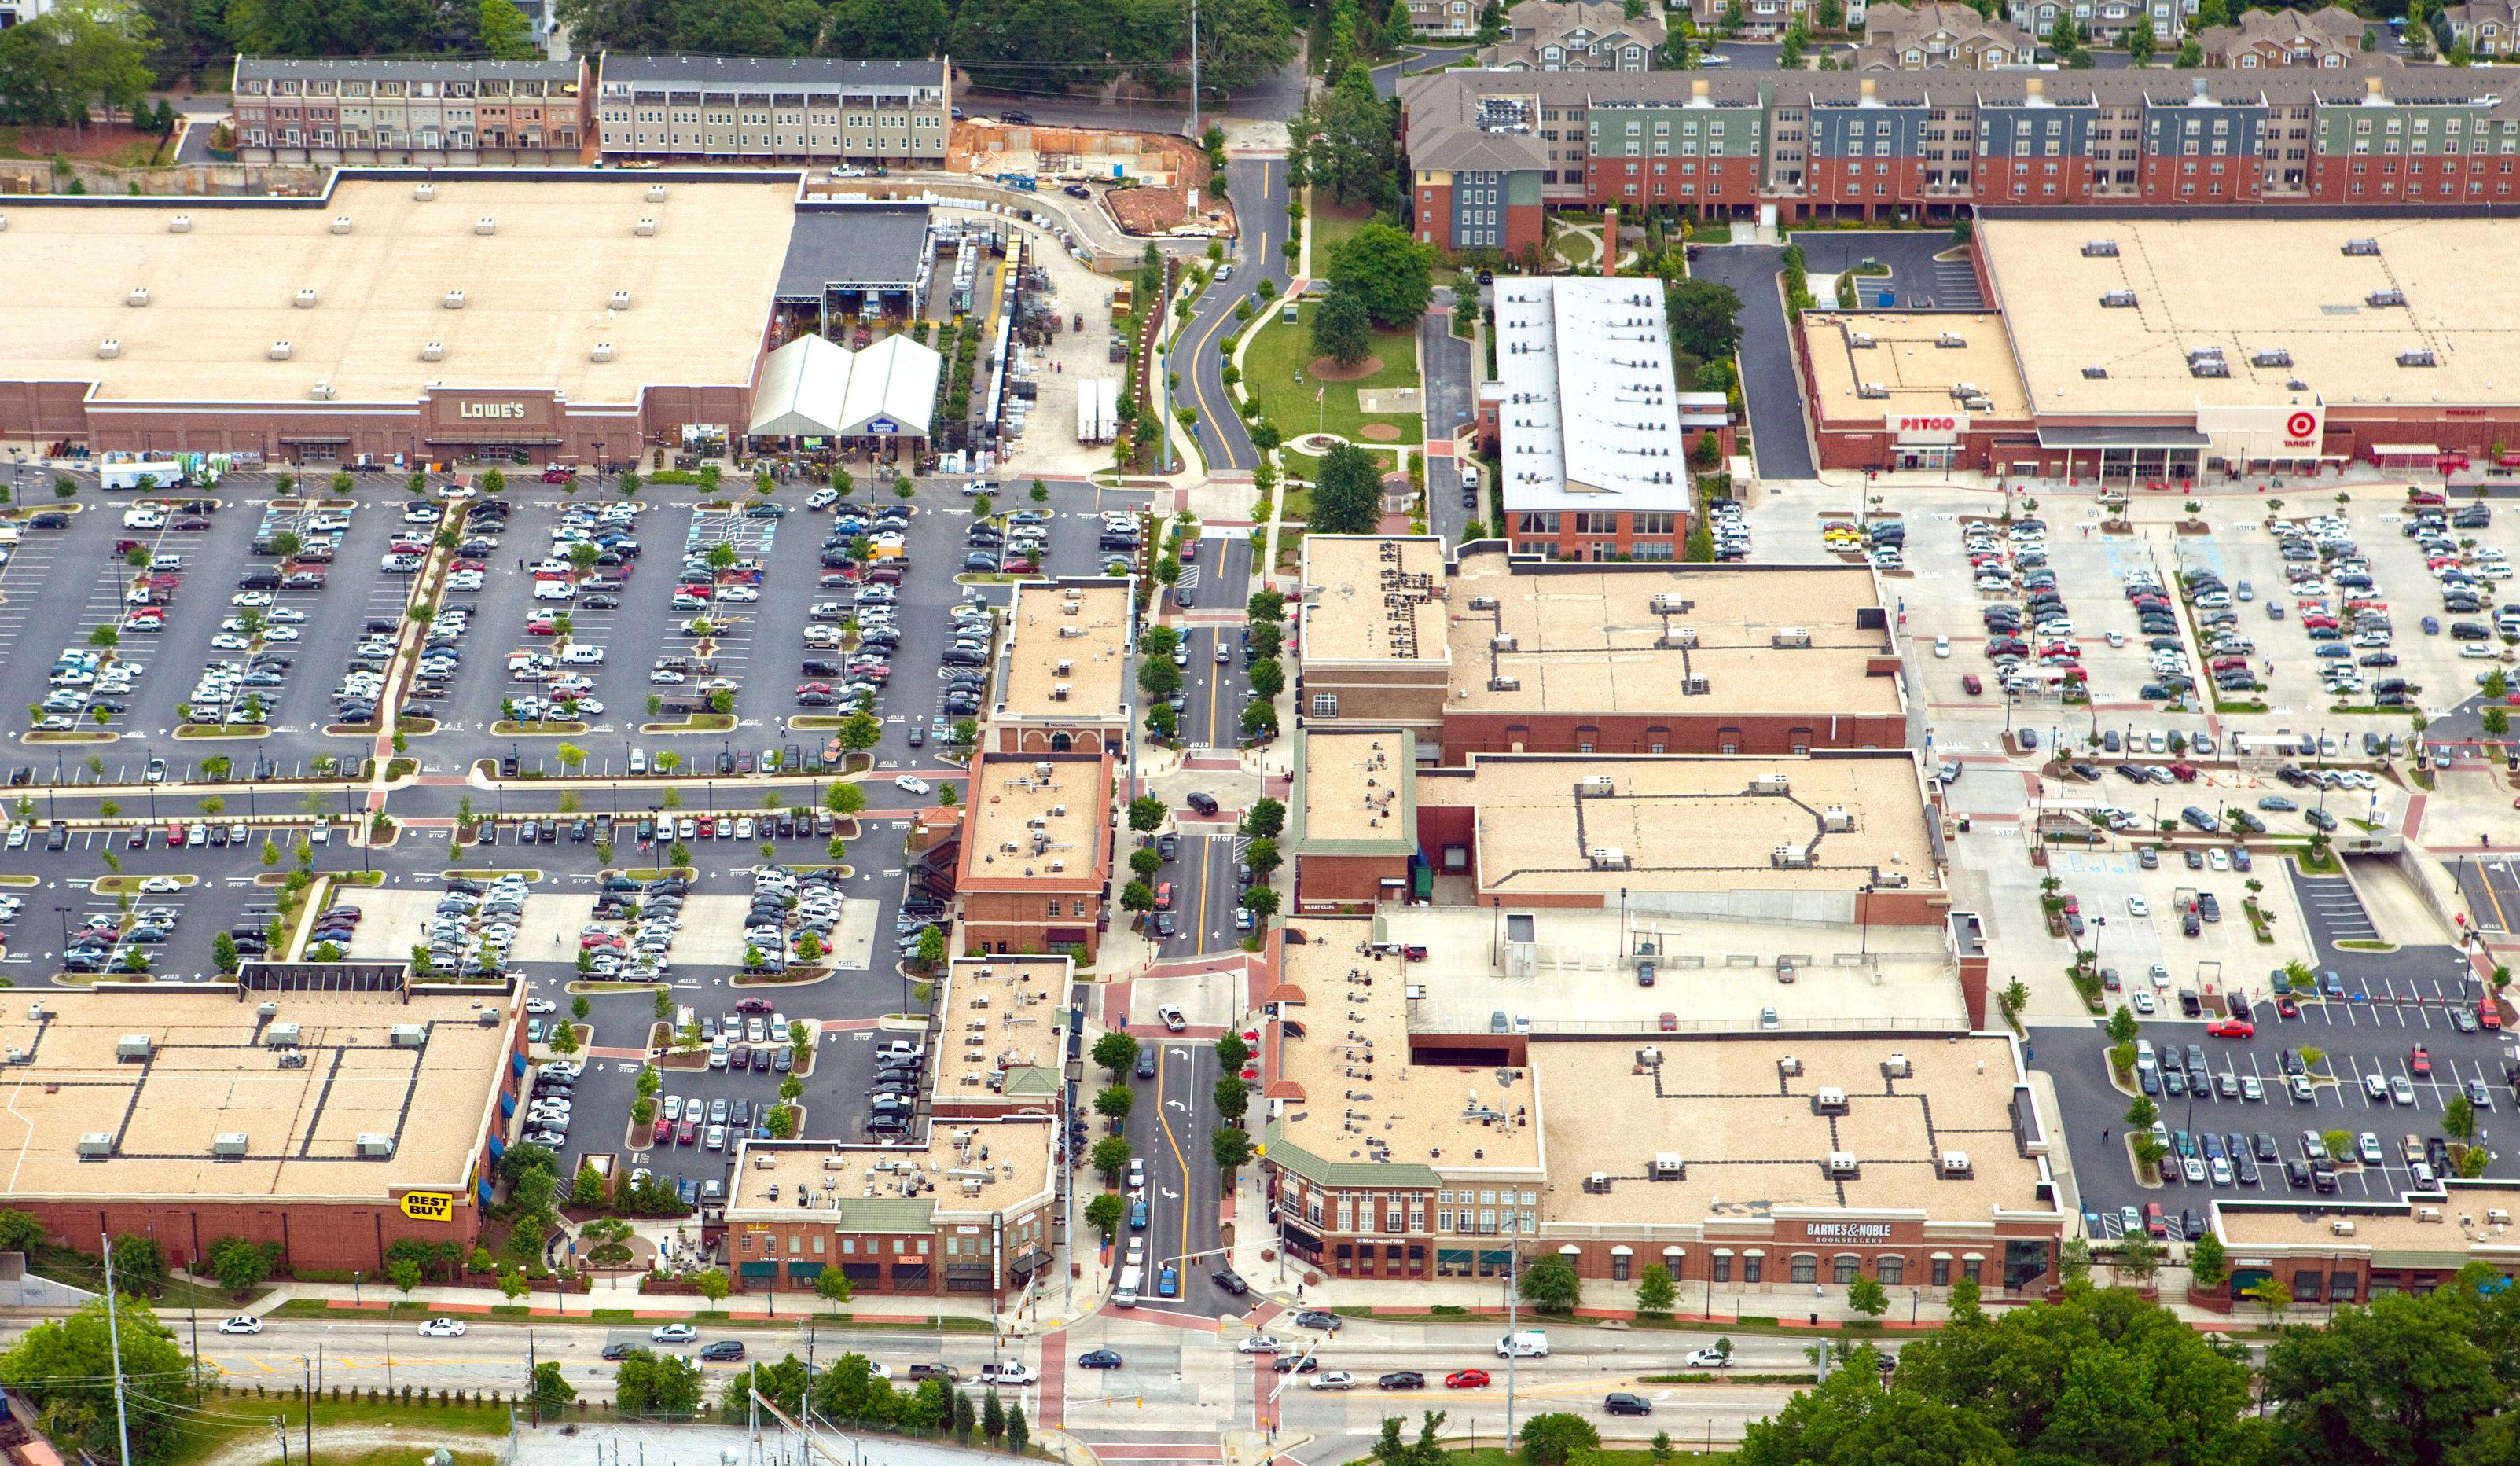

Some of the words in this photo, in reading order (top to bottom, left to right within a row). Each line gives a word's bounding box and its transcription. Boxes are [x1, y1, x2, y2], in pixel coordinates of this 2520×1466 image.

[461, 402, 525, 418] LOWE'S
[1901, 418, 1955, 431] PETCO
[408, 1196, 450, 1207] BEST
[410, 1205, 446, 1216] BUY
[1807, 1223, 1847, 1236] BARNES
[1847, 1223, 1859, 1236] &
[1859, 1224, 1890, 1236] NOBLE
